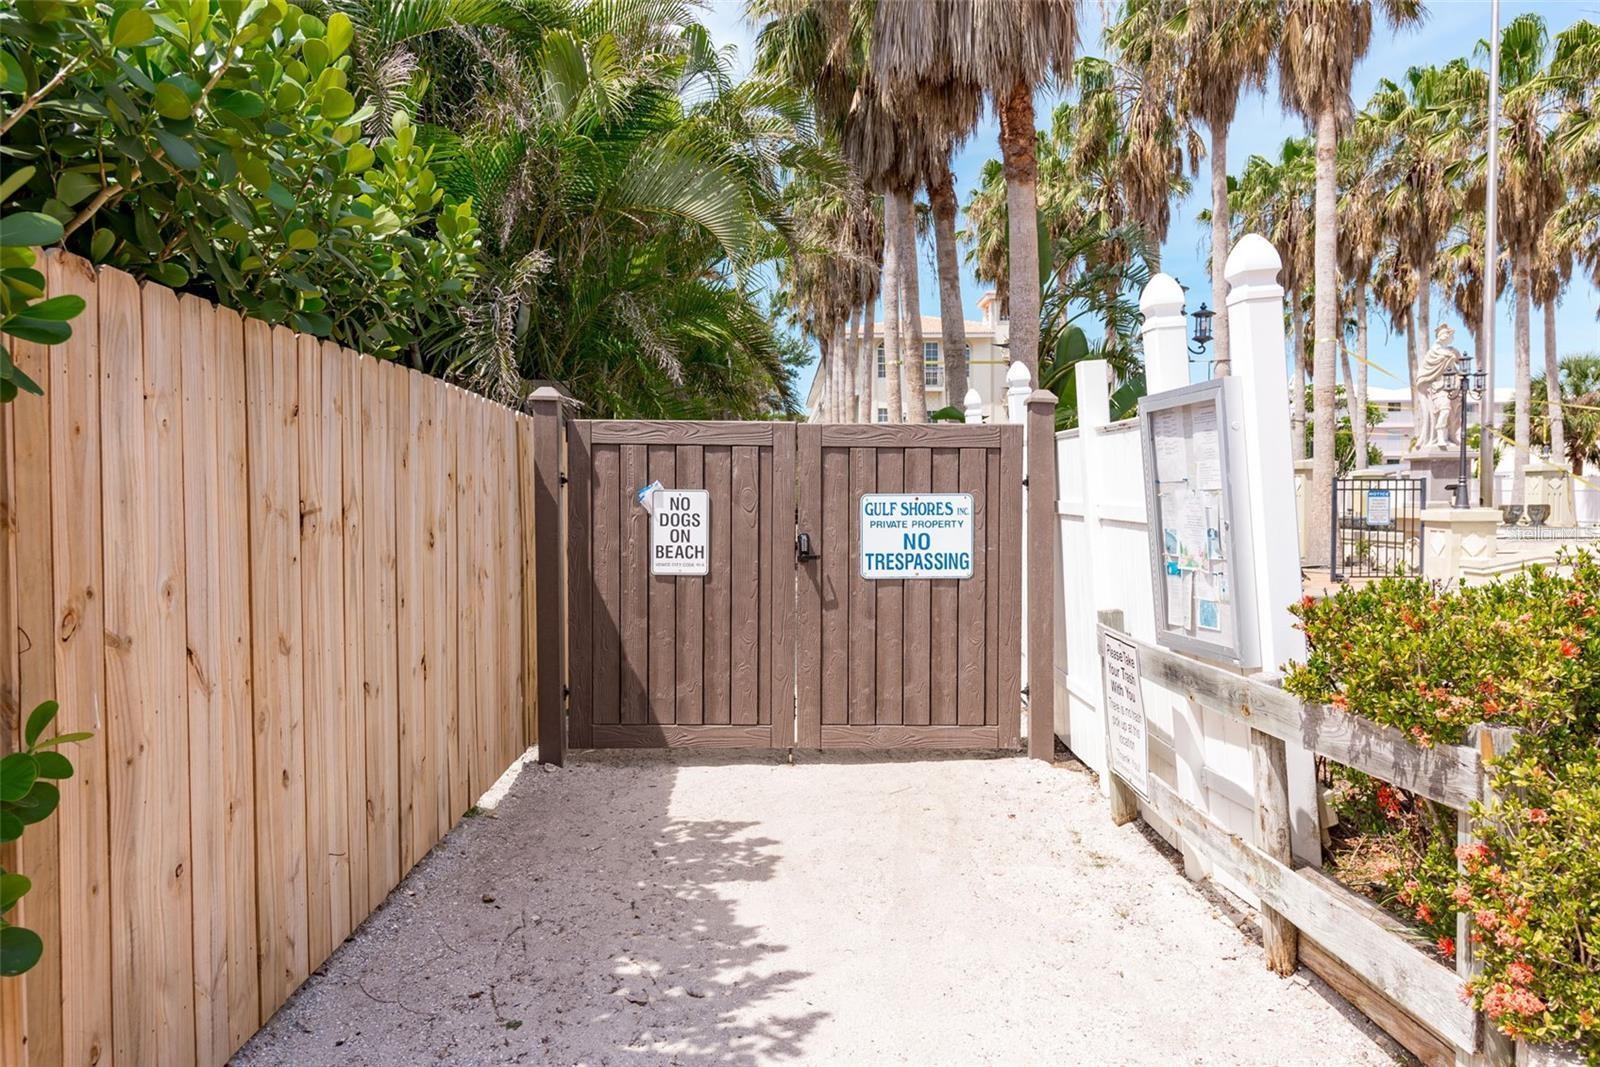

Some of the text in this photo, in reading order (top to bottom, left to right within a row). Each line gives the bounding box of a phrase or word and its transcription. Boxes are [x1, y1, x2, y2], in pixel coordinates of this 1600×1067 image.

[670, 497, 690, 511] NO
[864, 502, 897, 516] GULF
[901, 502, 953, 516] SHORES
[660, 513, 700, 527] DOGS
[870, 520, 964, 528] PRIVATE PROPERTY
[670, 529, 690, 543] ON
[903, 533, 931, 550] NO
[656, 545, 704, 559] BEACH
[865, 553, 970, 570] TRESPASSING
[1106, 643, 1135, 669] Please Take
[1108, 661, 1136, 686] Your Trash
[1111, 680, 1136, 703] With You
